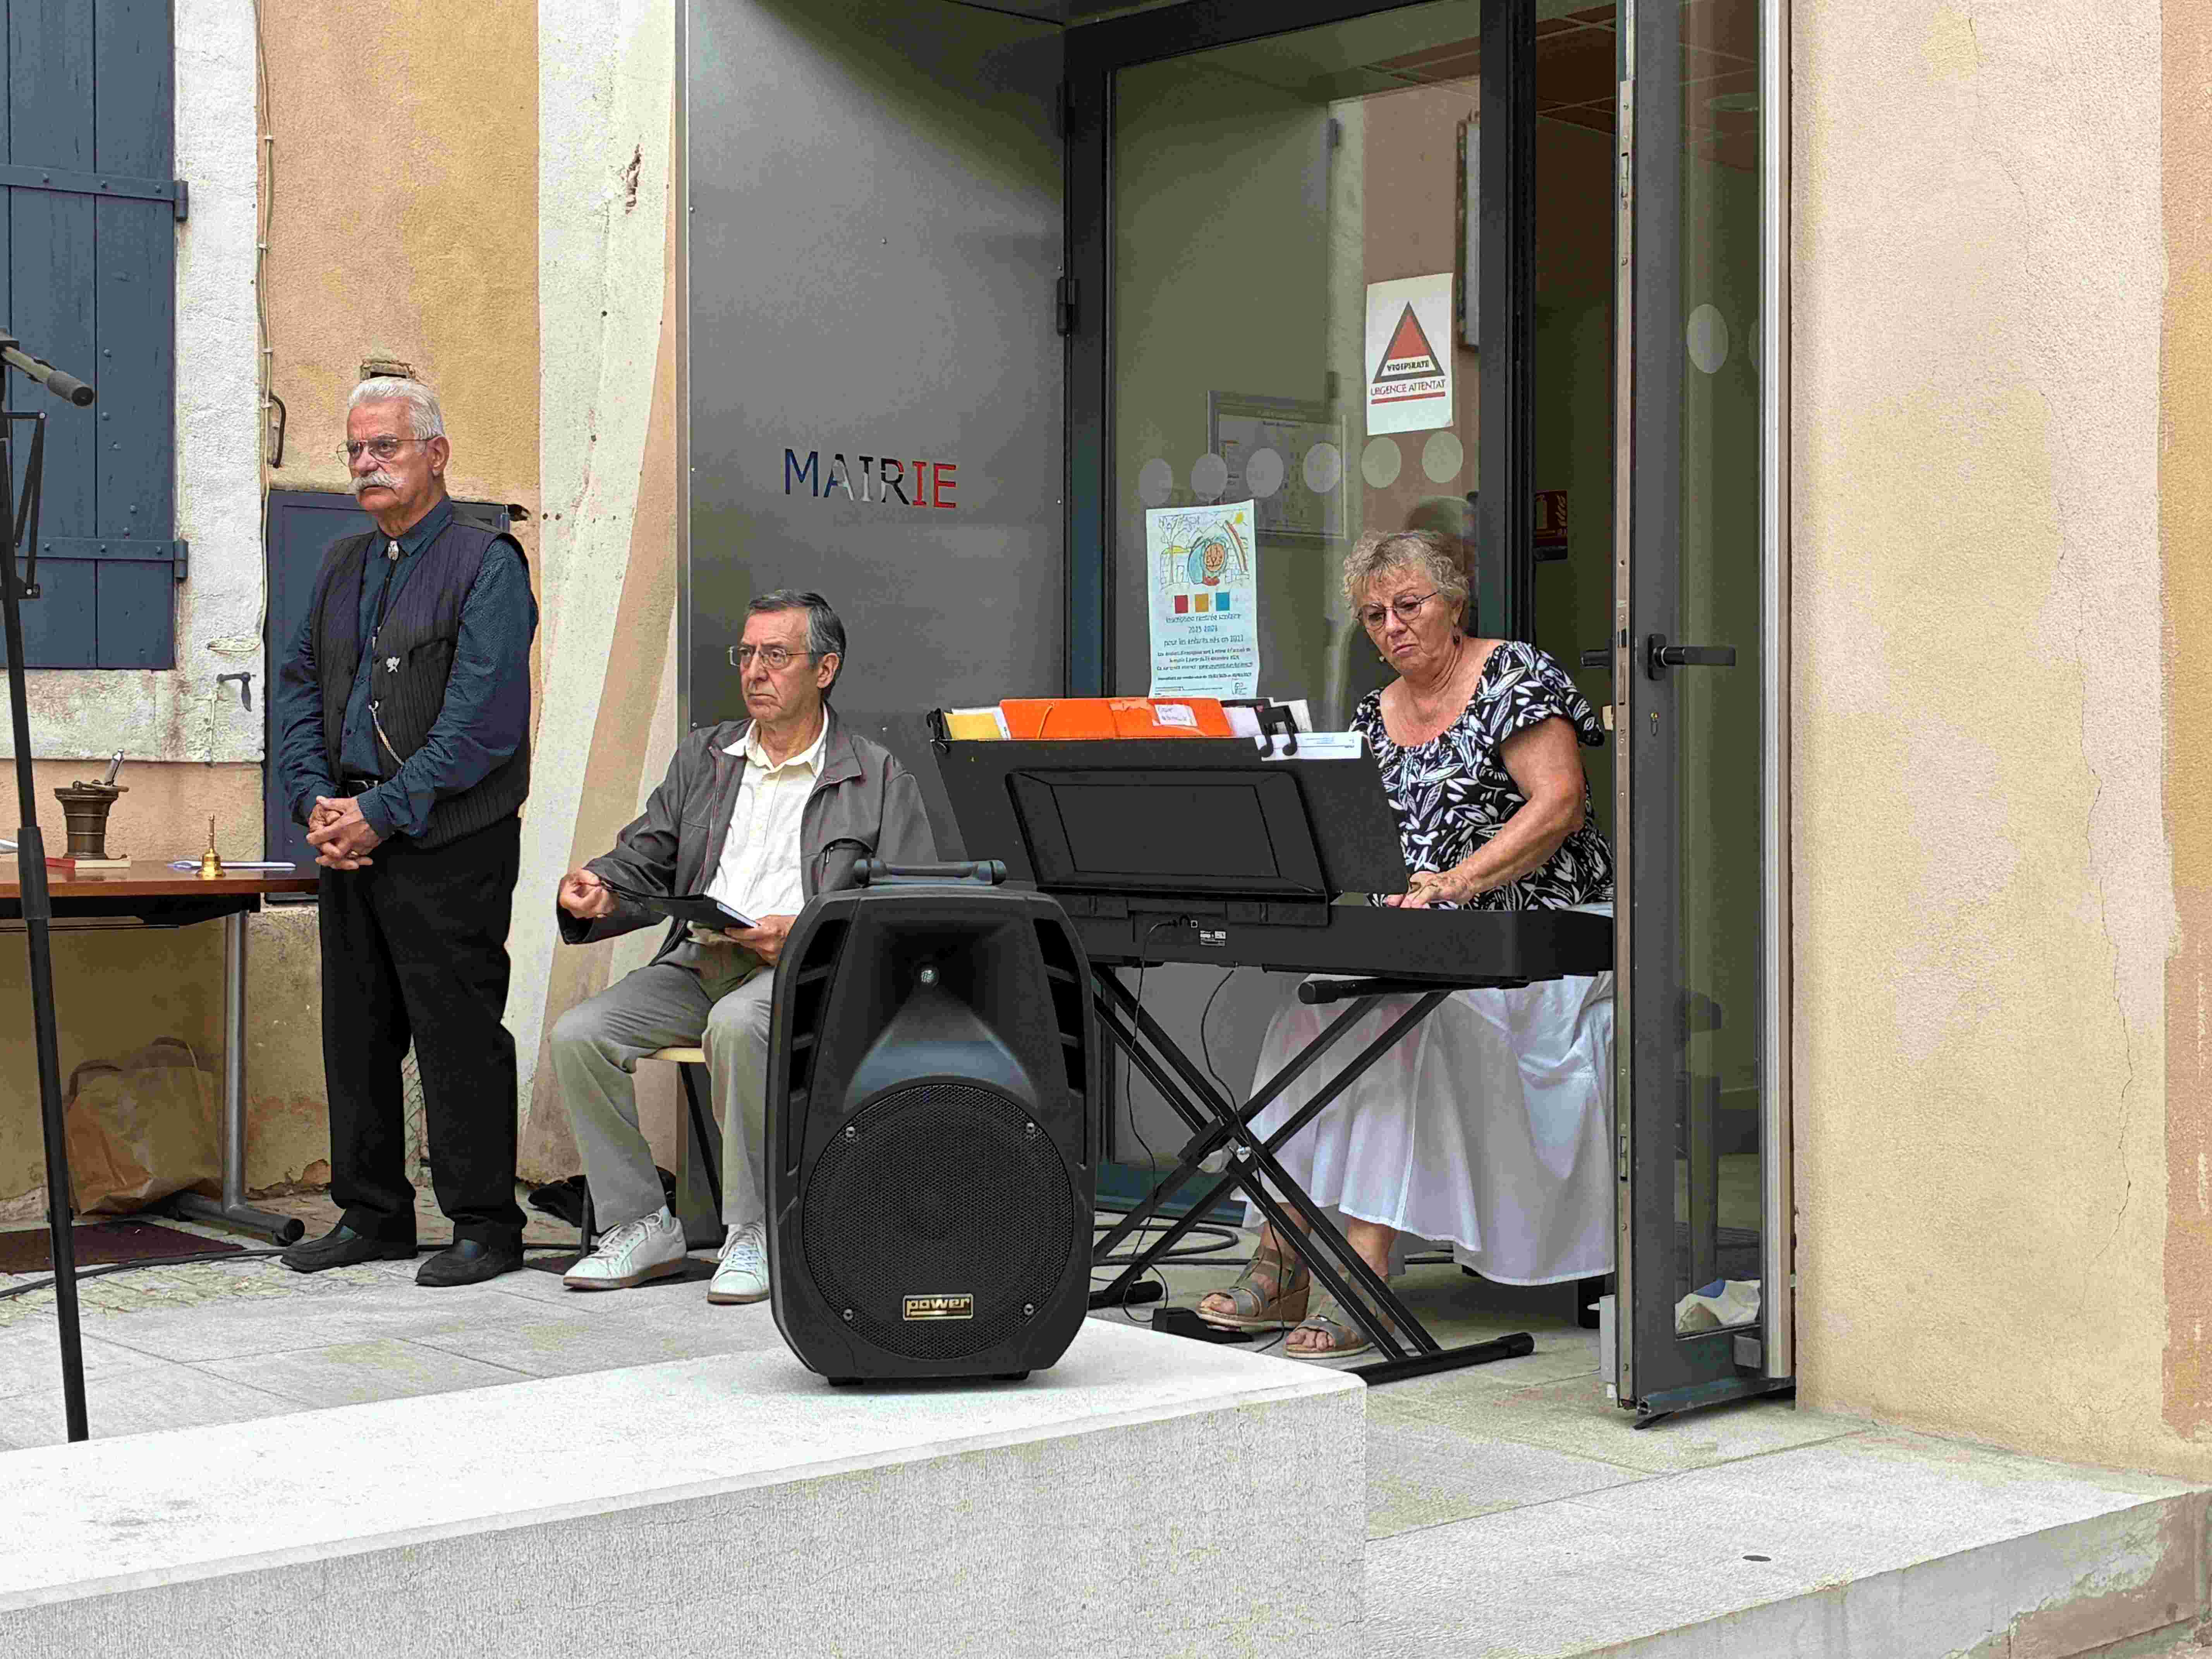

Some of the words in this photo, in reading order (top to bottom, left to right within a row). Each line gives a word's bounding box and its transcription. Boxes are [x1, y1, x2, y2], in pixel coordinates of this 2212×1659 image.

[1371, 384, 1407, 395] URGENCE
[1408, 379, 1446, 392] ATTENTAT
[785, 448, 957, 508] MAIRIE
[907, 1298, 970, 1316] power
